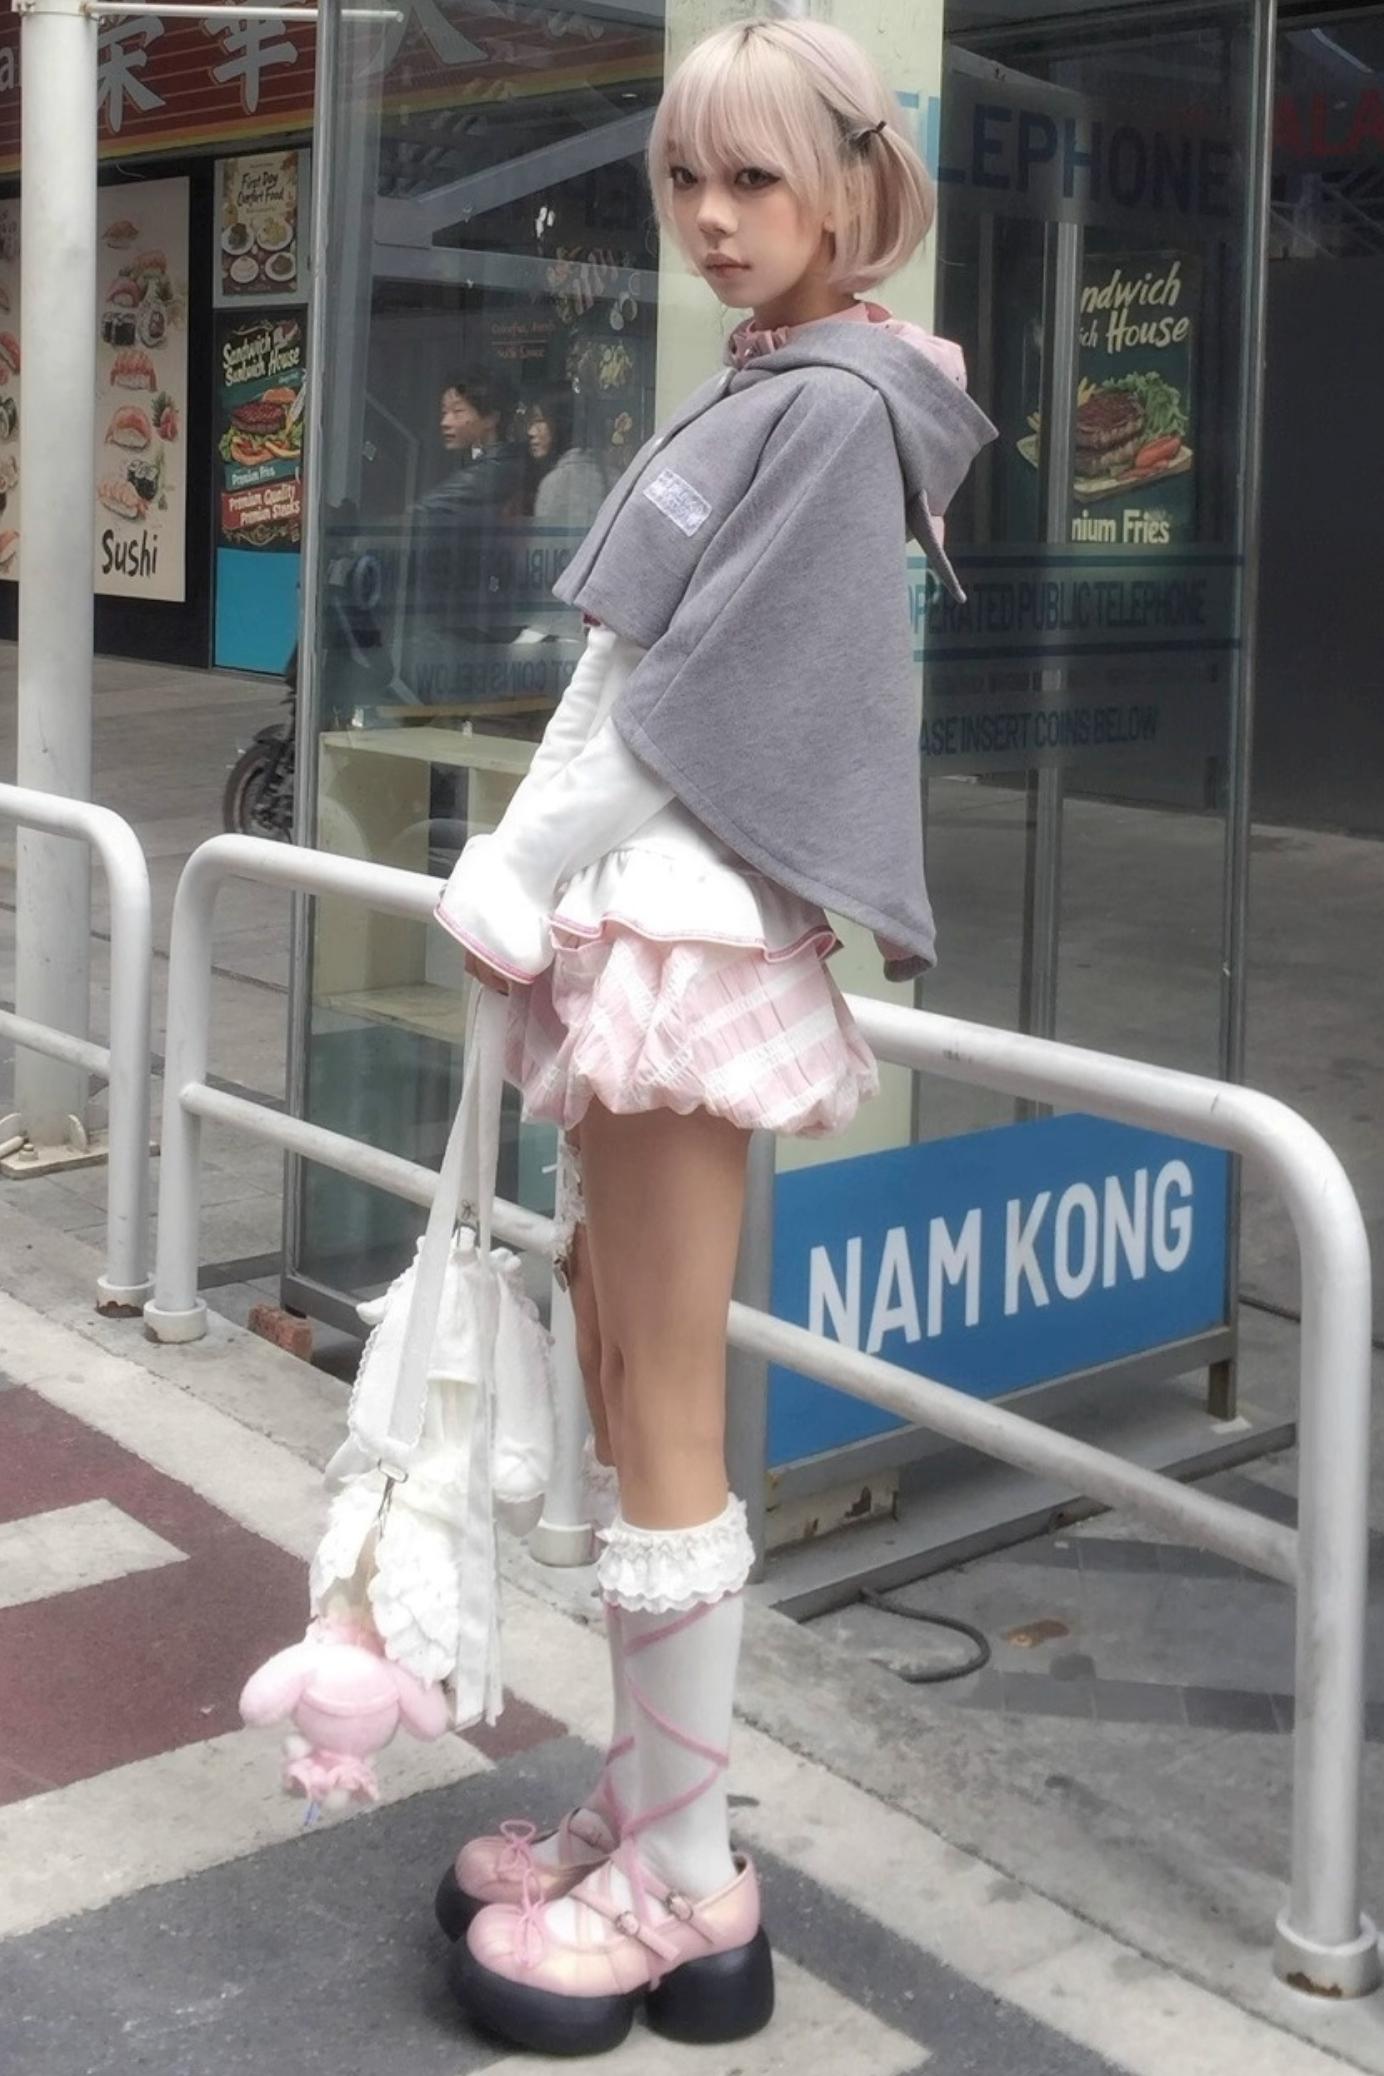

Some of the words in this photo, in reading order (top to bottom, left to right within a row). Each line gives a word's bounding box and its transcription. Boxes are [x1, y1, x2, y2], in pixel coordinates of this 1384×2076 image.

[223, 331, 271, 369] Sandwich
[1105, 308, 1190, 354] House
[225, 354, 267, 387] Sandwich
[268, 346, 300, 376] House
[263, 482, 296, 506] Quality
[1123, 509, 1170, 544] Fries
[101, 529, 158, 577] Sushi
[960, 711, 1032, 754] INSERT
[808, 1207, 982, 1354] NAM
[1004, 1159, 1193, 1316] KONG
